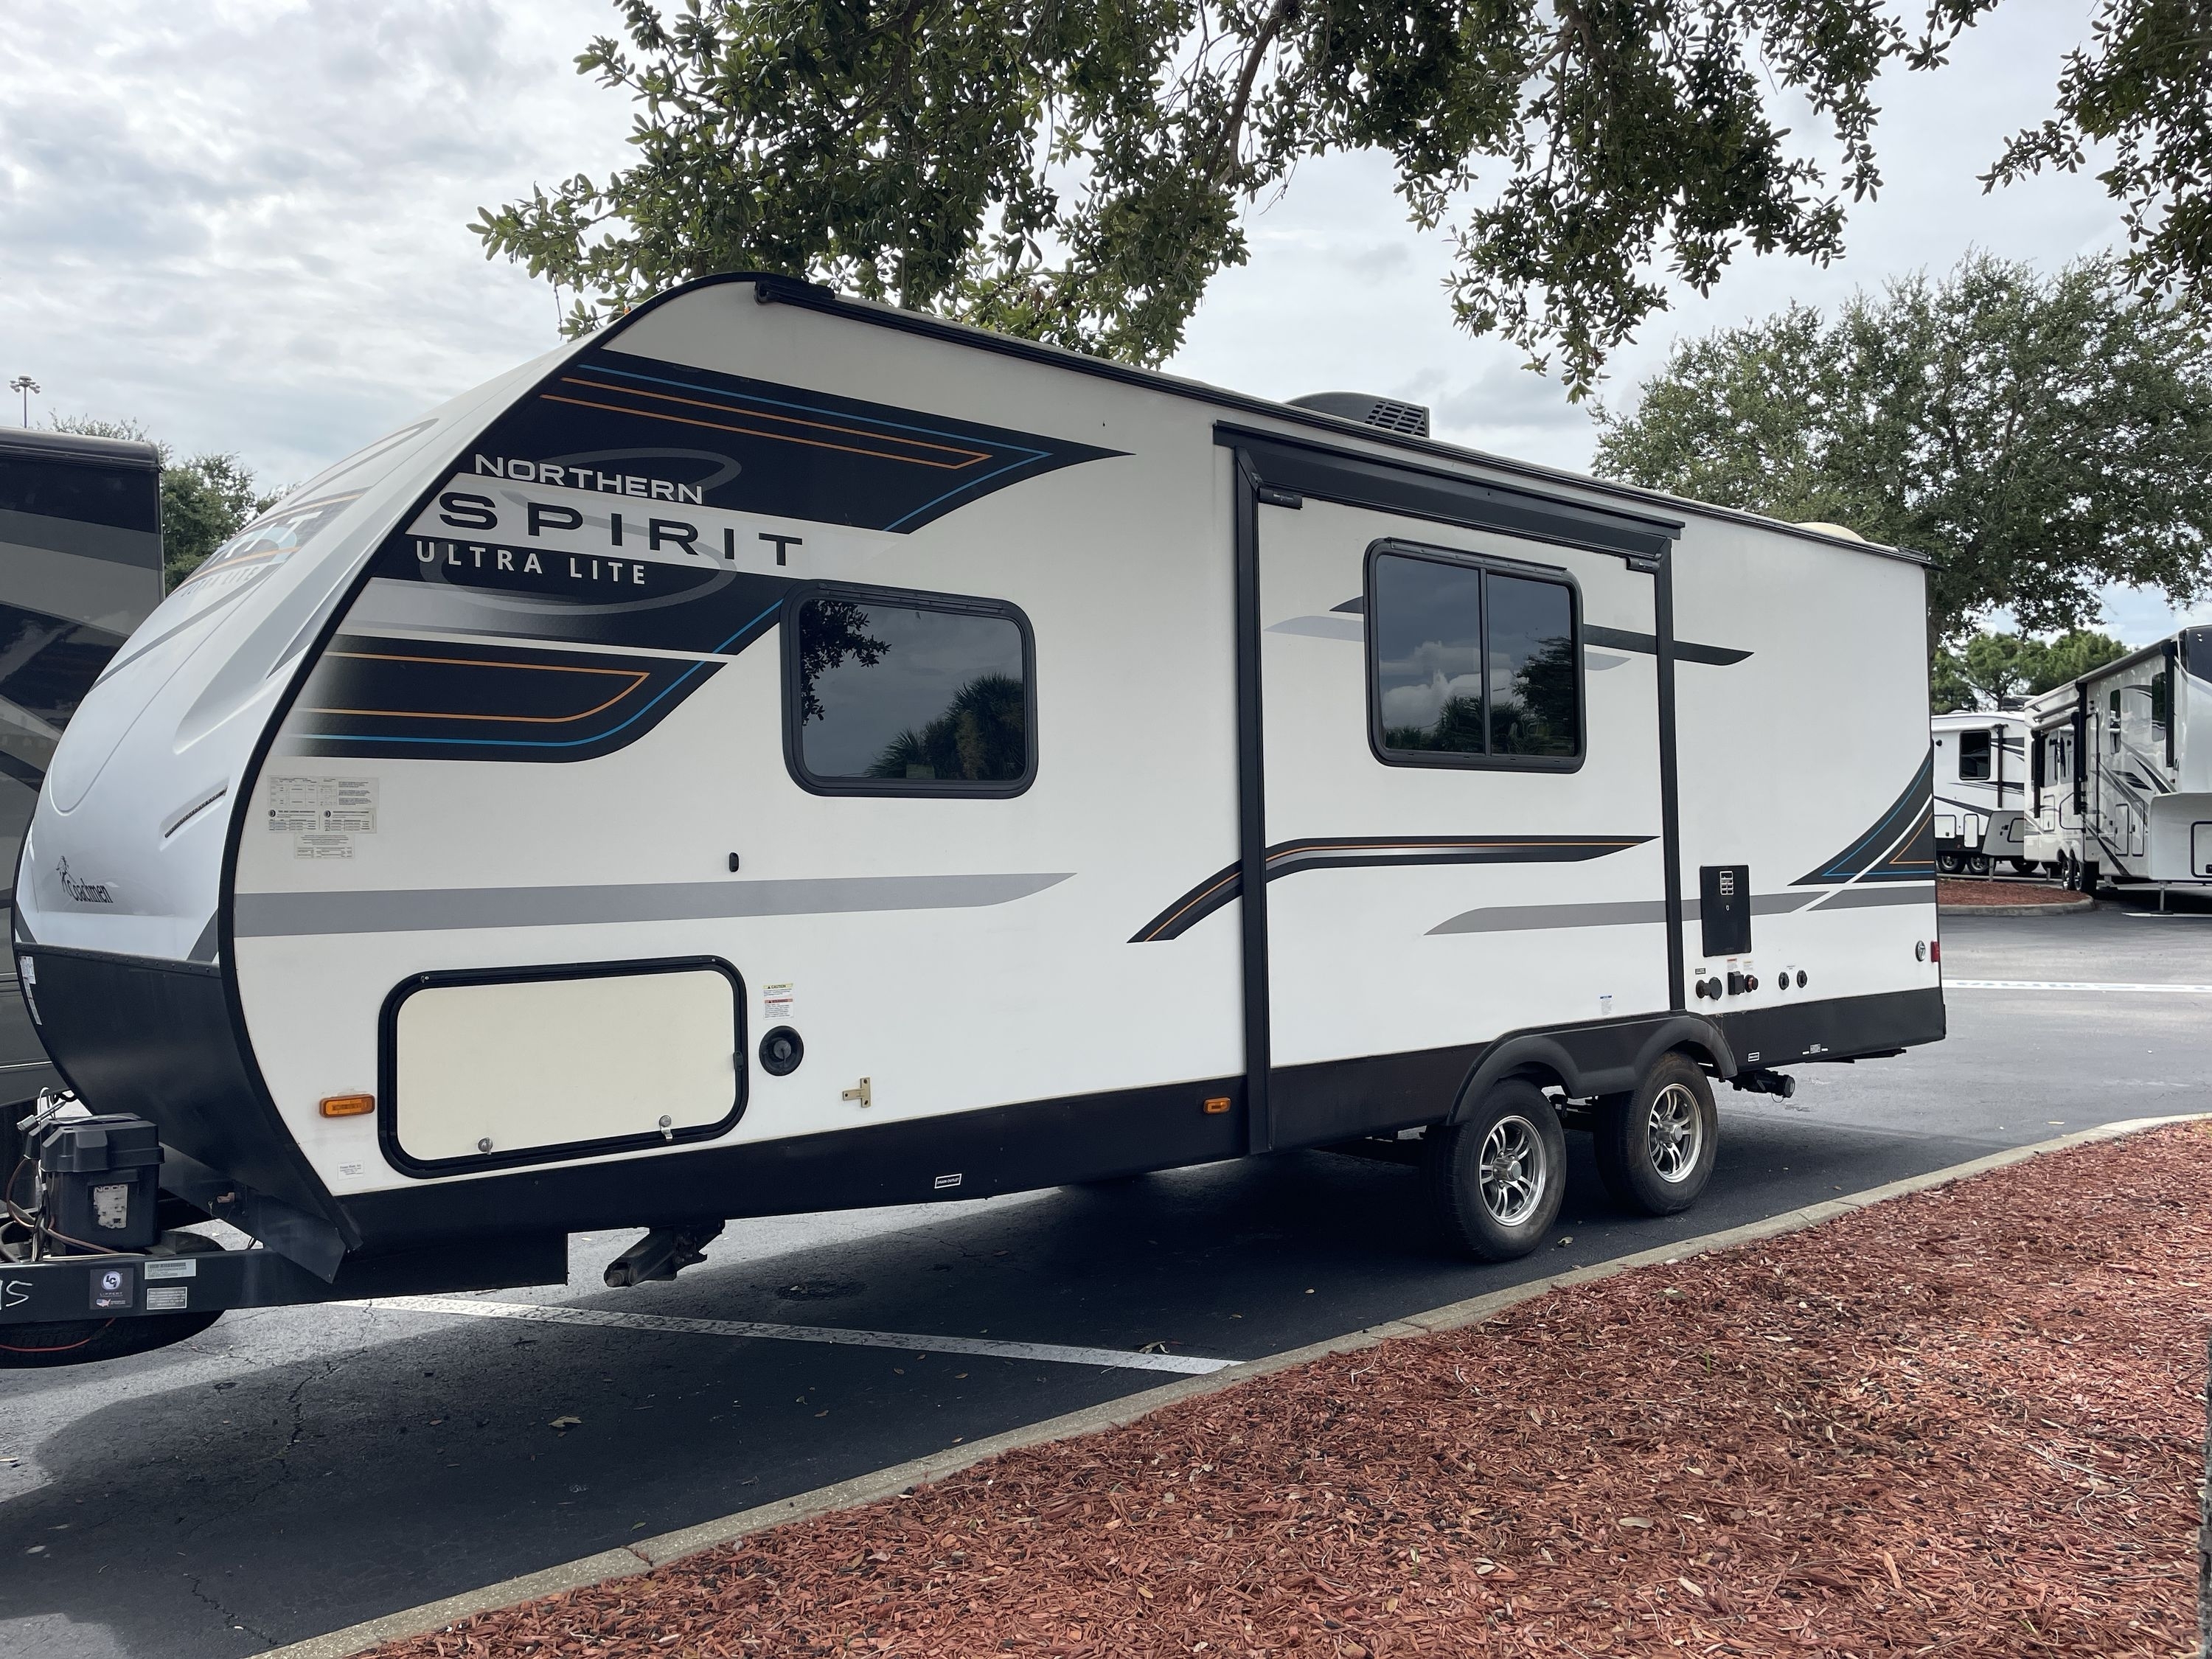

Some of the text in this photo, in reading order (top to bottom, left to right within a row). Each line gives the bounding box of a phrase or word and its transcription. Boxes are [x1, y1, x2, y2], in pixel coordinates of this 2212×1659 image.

[476, 454, 703, 504] NORTHERN
[439, 492, 803, 566] SPIRIT
[417, 540, 645, 585] ULTRA LITE
[67, 877, 114, 903] Coachmen
